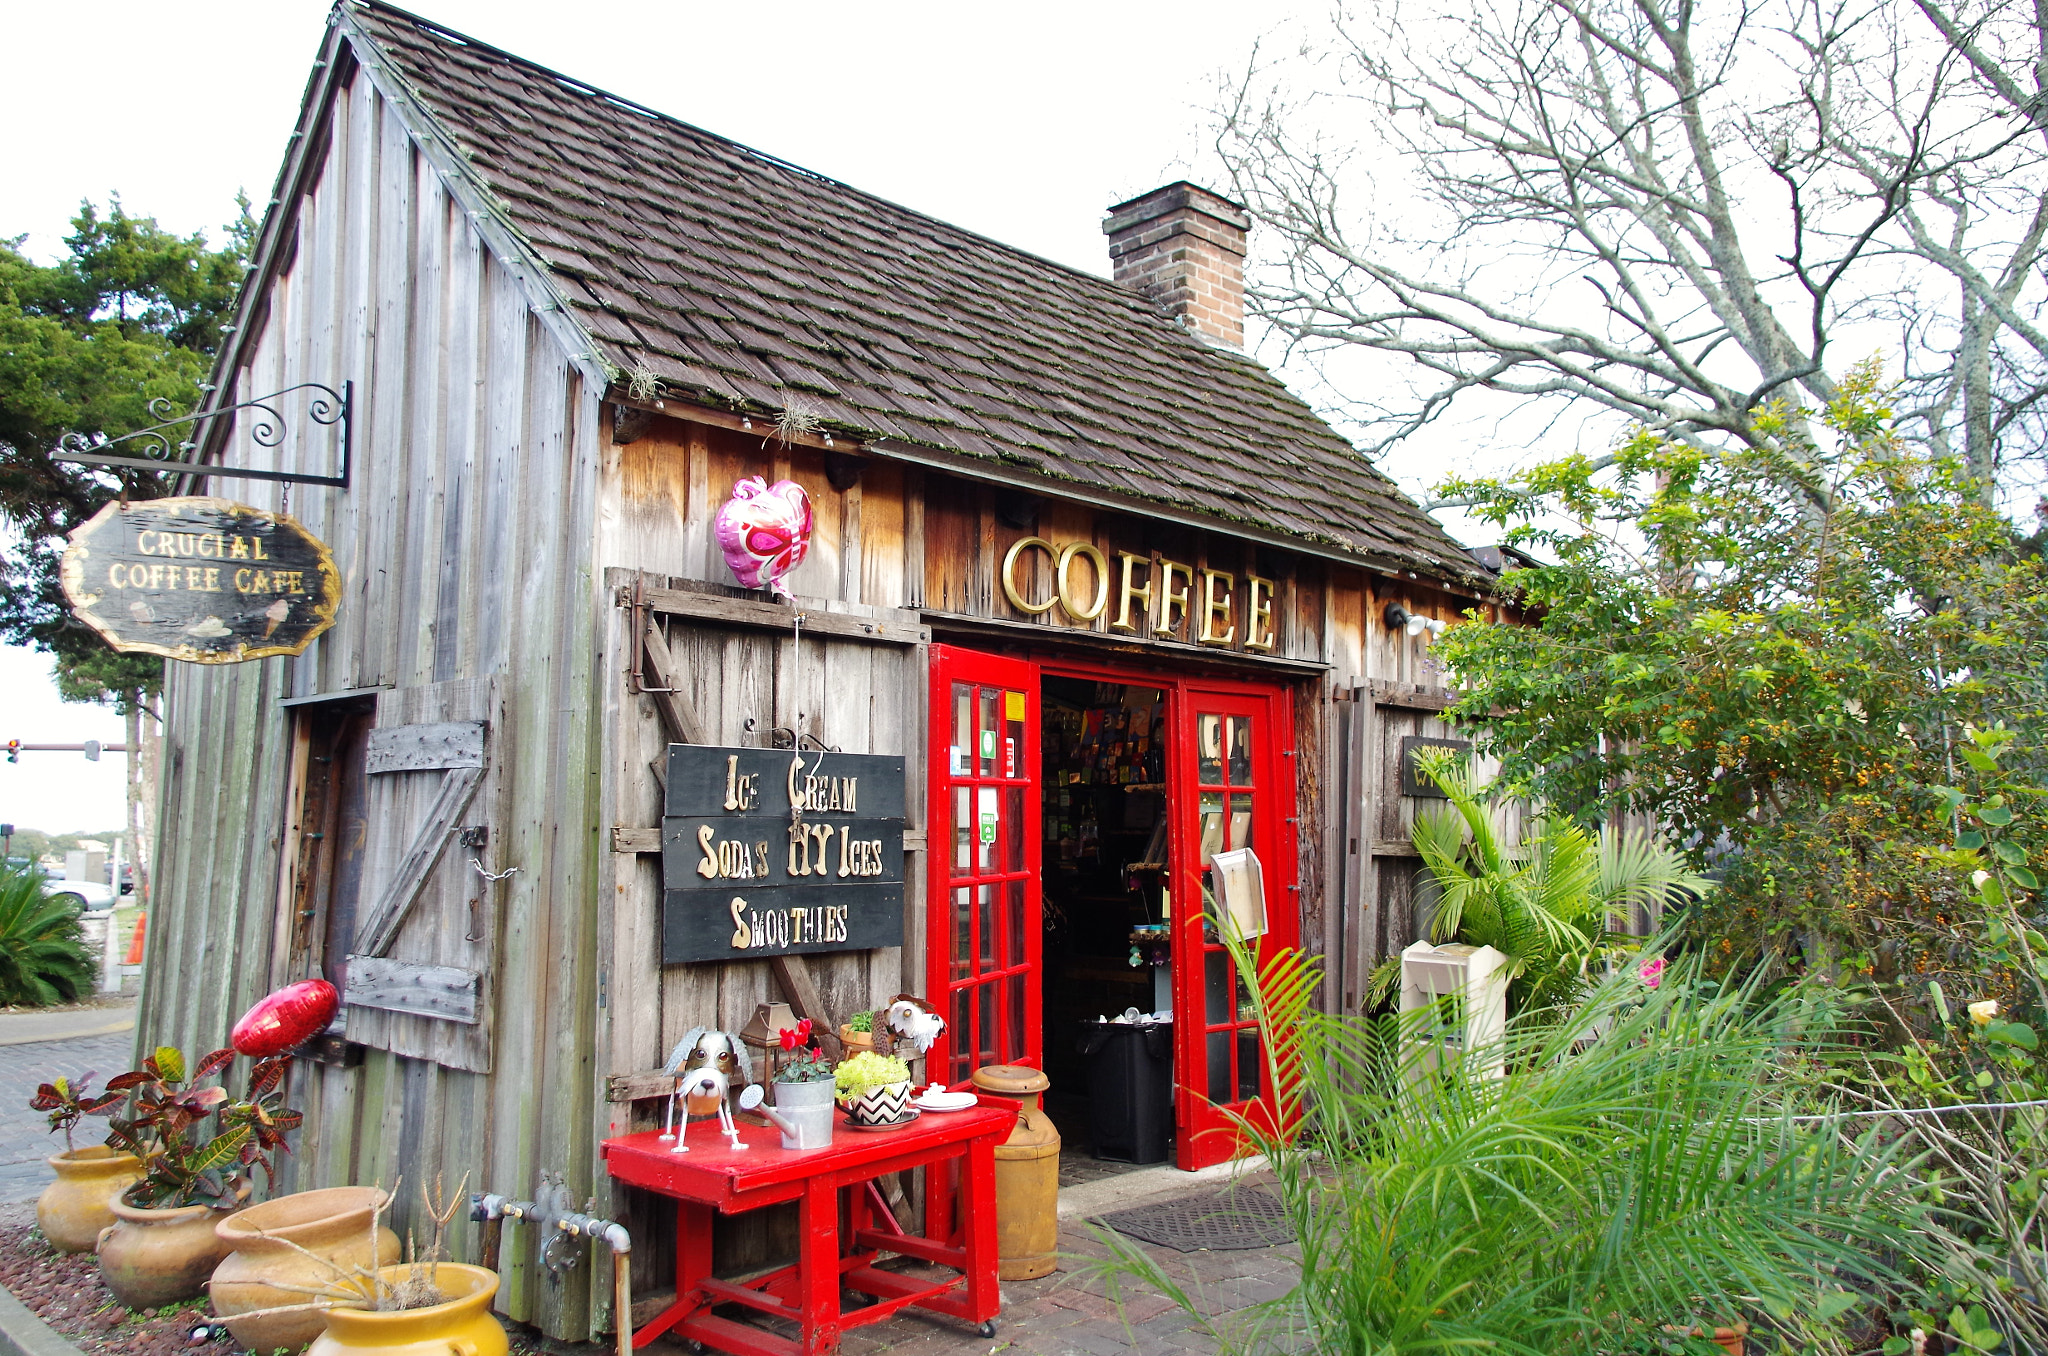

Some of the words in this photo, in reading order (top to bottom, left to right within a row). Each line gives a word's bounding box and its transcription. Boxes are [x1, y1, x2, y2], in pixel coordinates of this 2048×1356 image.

[138, 530, 269, 560] CRUCIAL
[109, 562, 222, 593] COFFEE
[234, 568, 305, 594] CAFE
[1002, 535, 1274, 651] COFFEE
[723, 754, 761, 811] ICE
[787, 756, 858, 813] CREAM
[697, 824, 769, 879] SODAS
[787, 823, 835, 876] NY
[837, 825, 883, 878] ICES
[730, 896, 849, 949] SMOOTHIES
